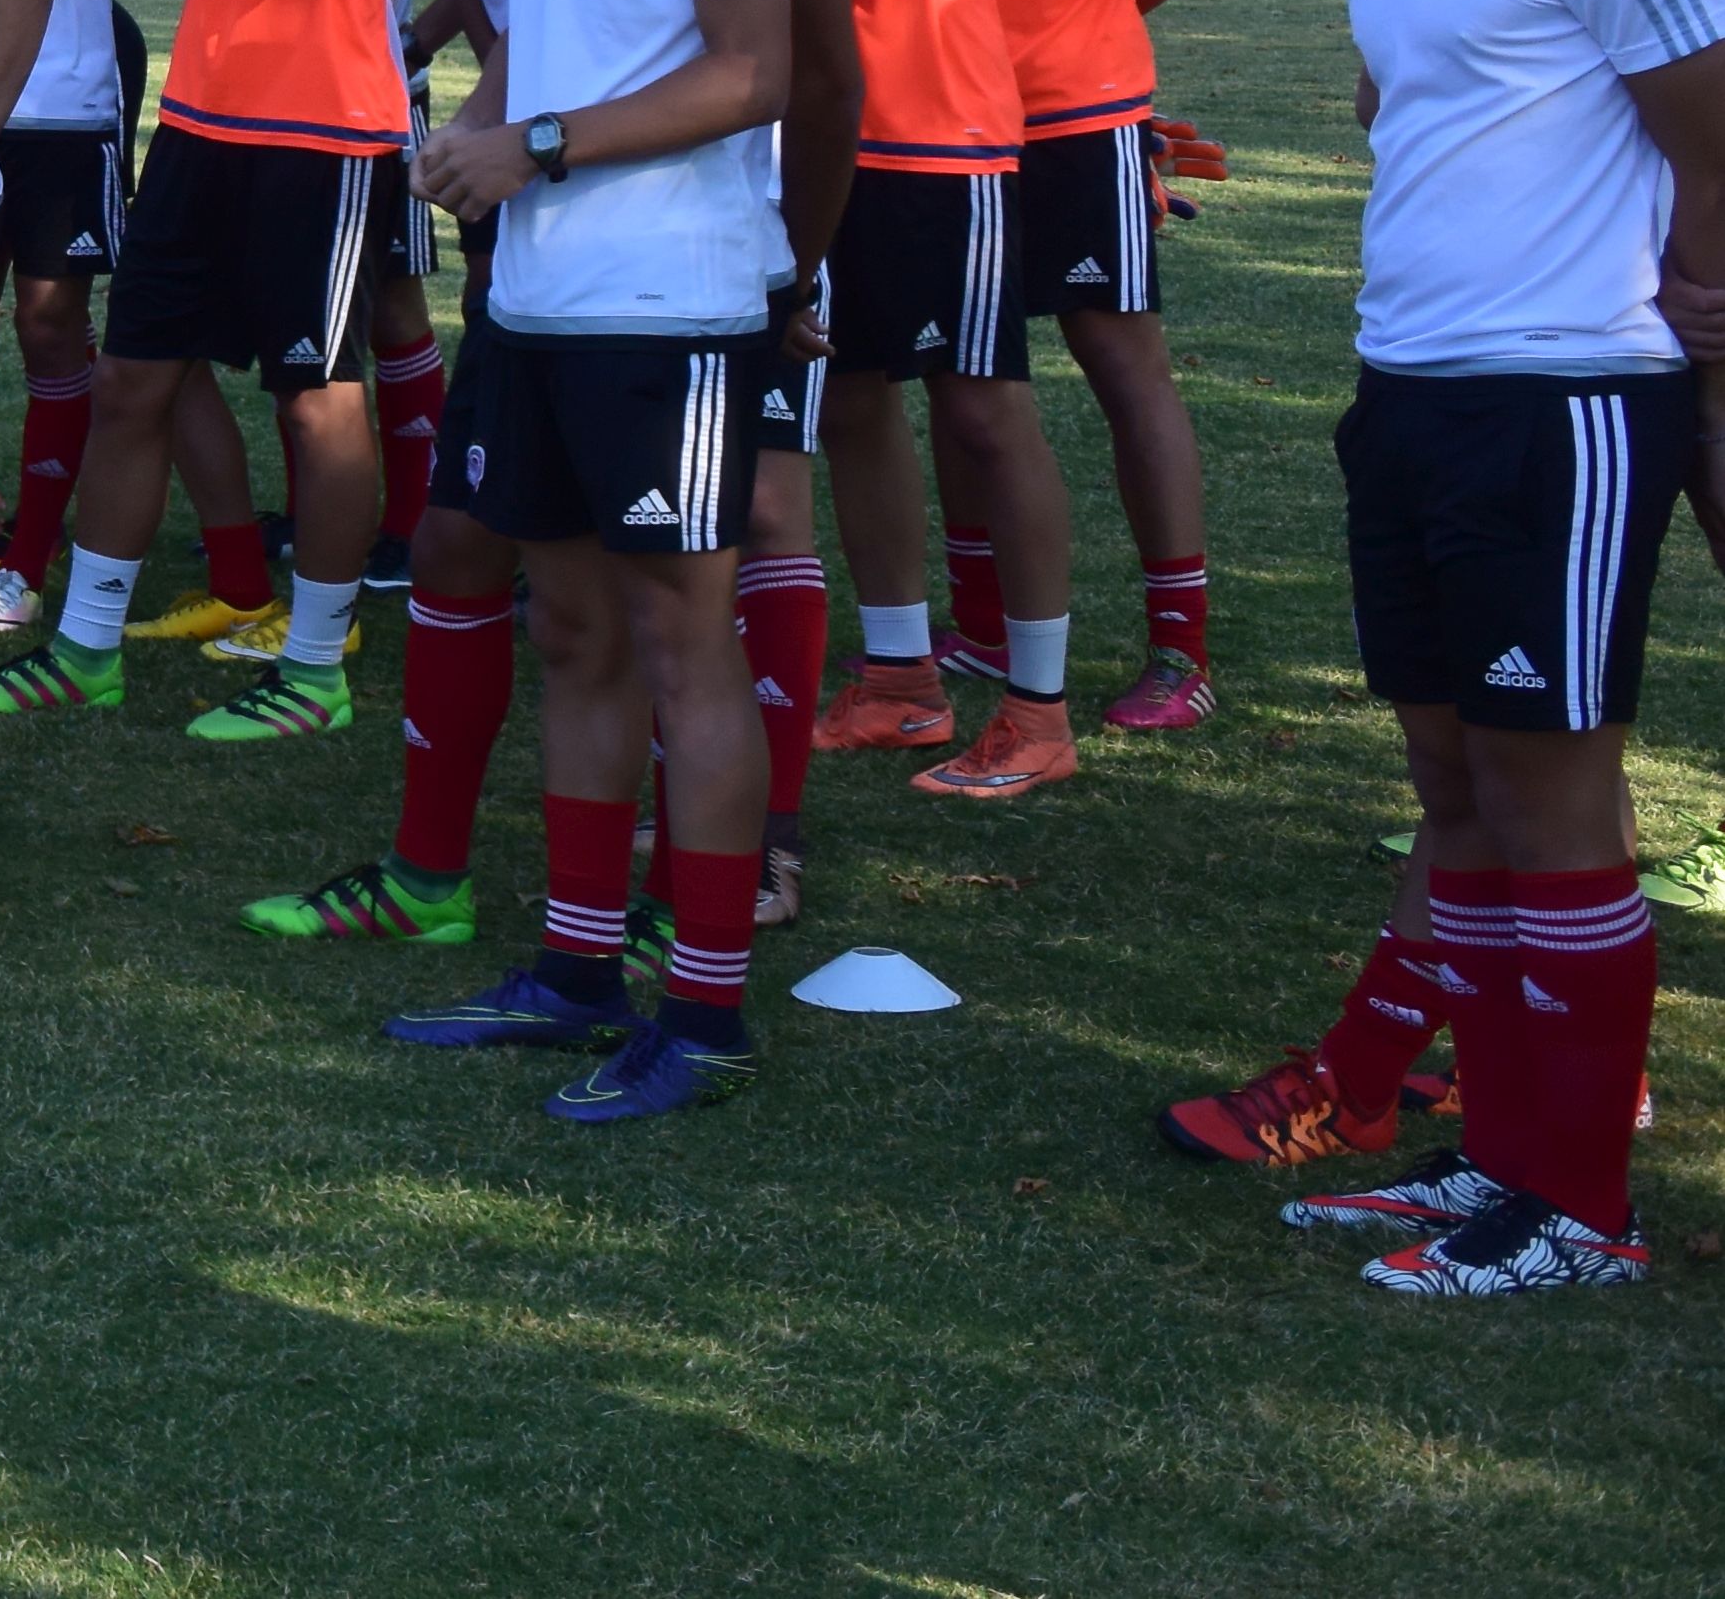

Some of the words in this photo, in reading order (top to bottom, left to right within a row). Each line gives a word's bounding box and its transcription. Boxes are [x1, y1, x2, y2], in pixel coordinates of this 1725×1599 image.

[1065, 274, 1110, 283] adidas
[283, 354, 326, 364] adidas
[622, 510, 681, 525] adidas
[1483, 668, 1547, 689] adidas
